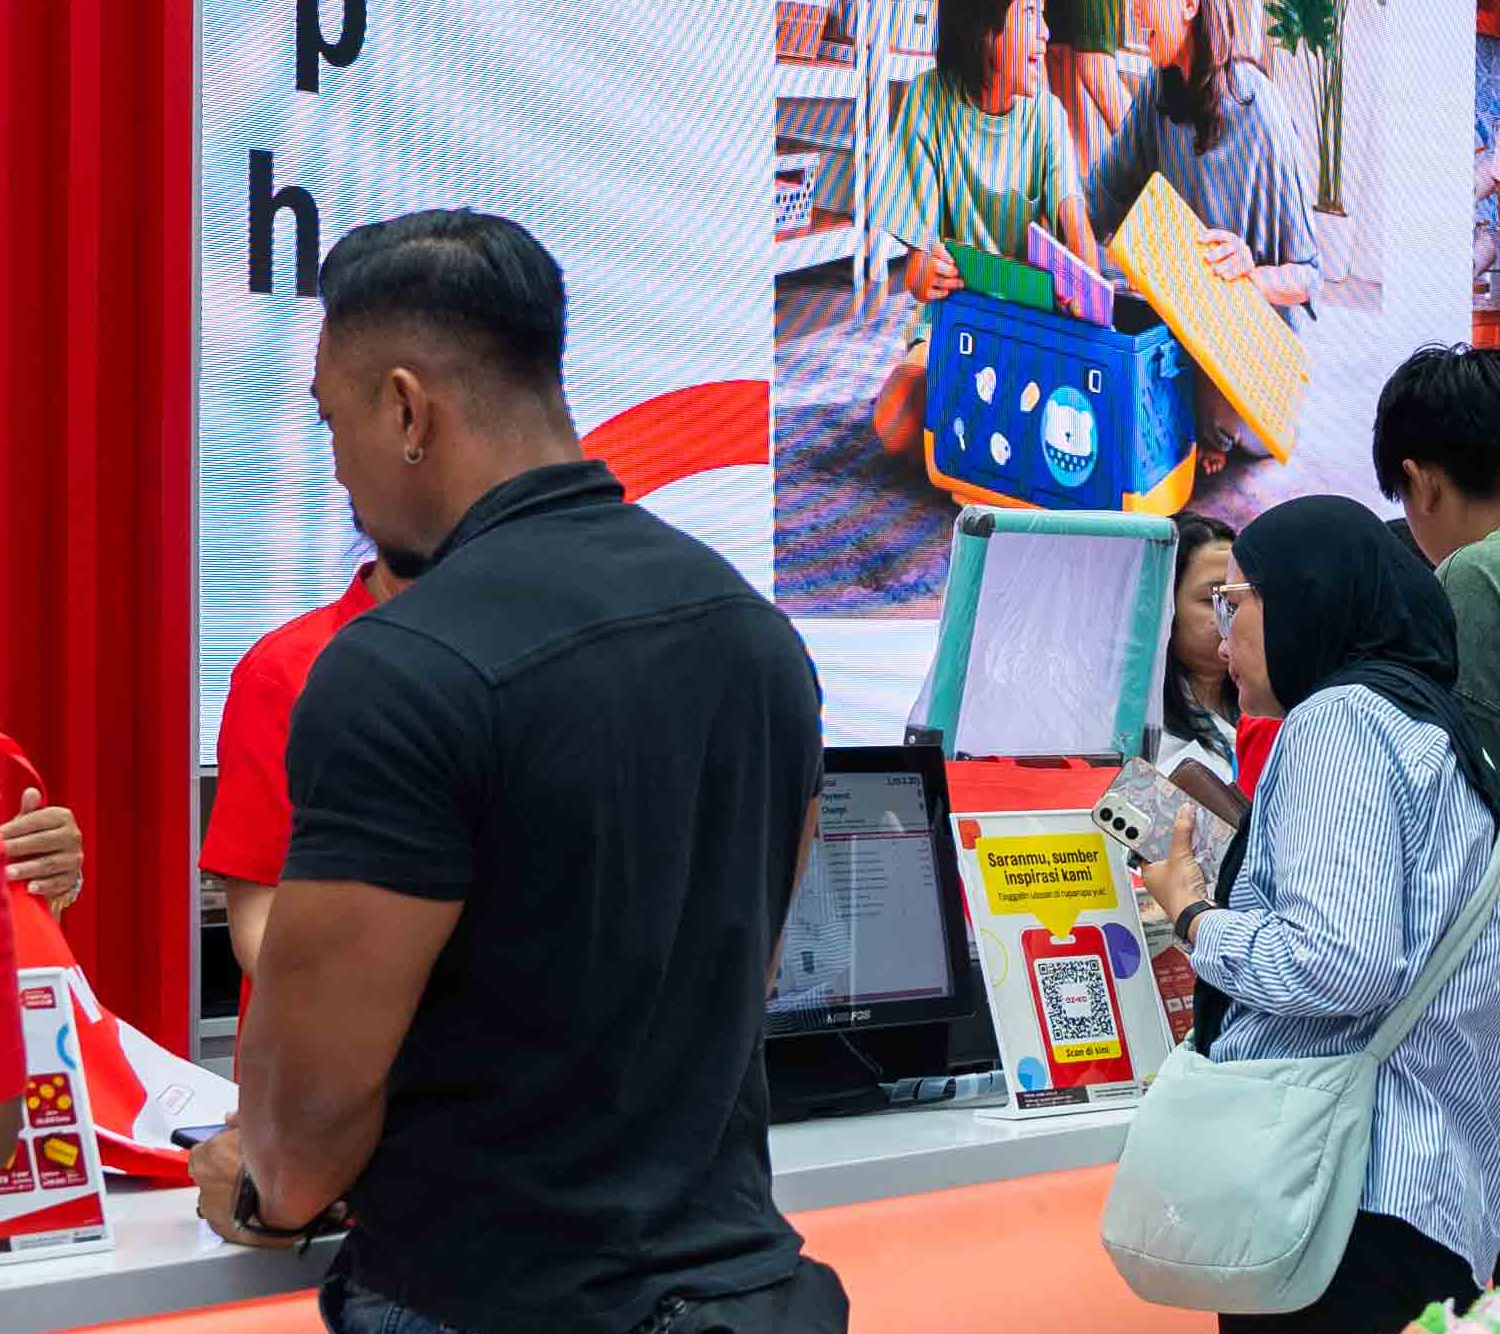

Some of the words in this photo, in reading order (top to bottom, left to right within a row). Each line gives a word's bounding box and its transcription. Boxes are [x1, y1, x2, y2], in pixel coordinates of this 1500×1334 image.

[987, 851, 1050, 867] Saranmu,
[1051, 848, 1099, 864] sumber
[1004, 867, 1060, 887] inspirasi
[1061, 866, 1092, 881] kami
